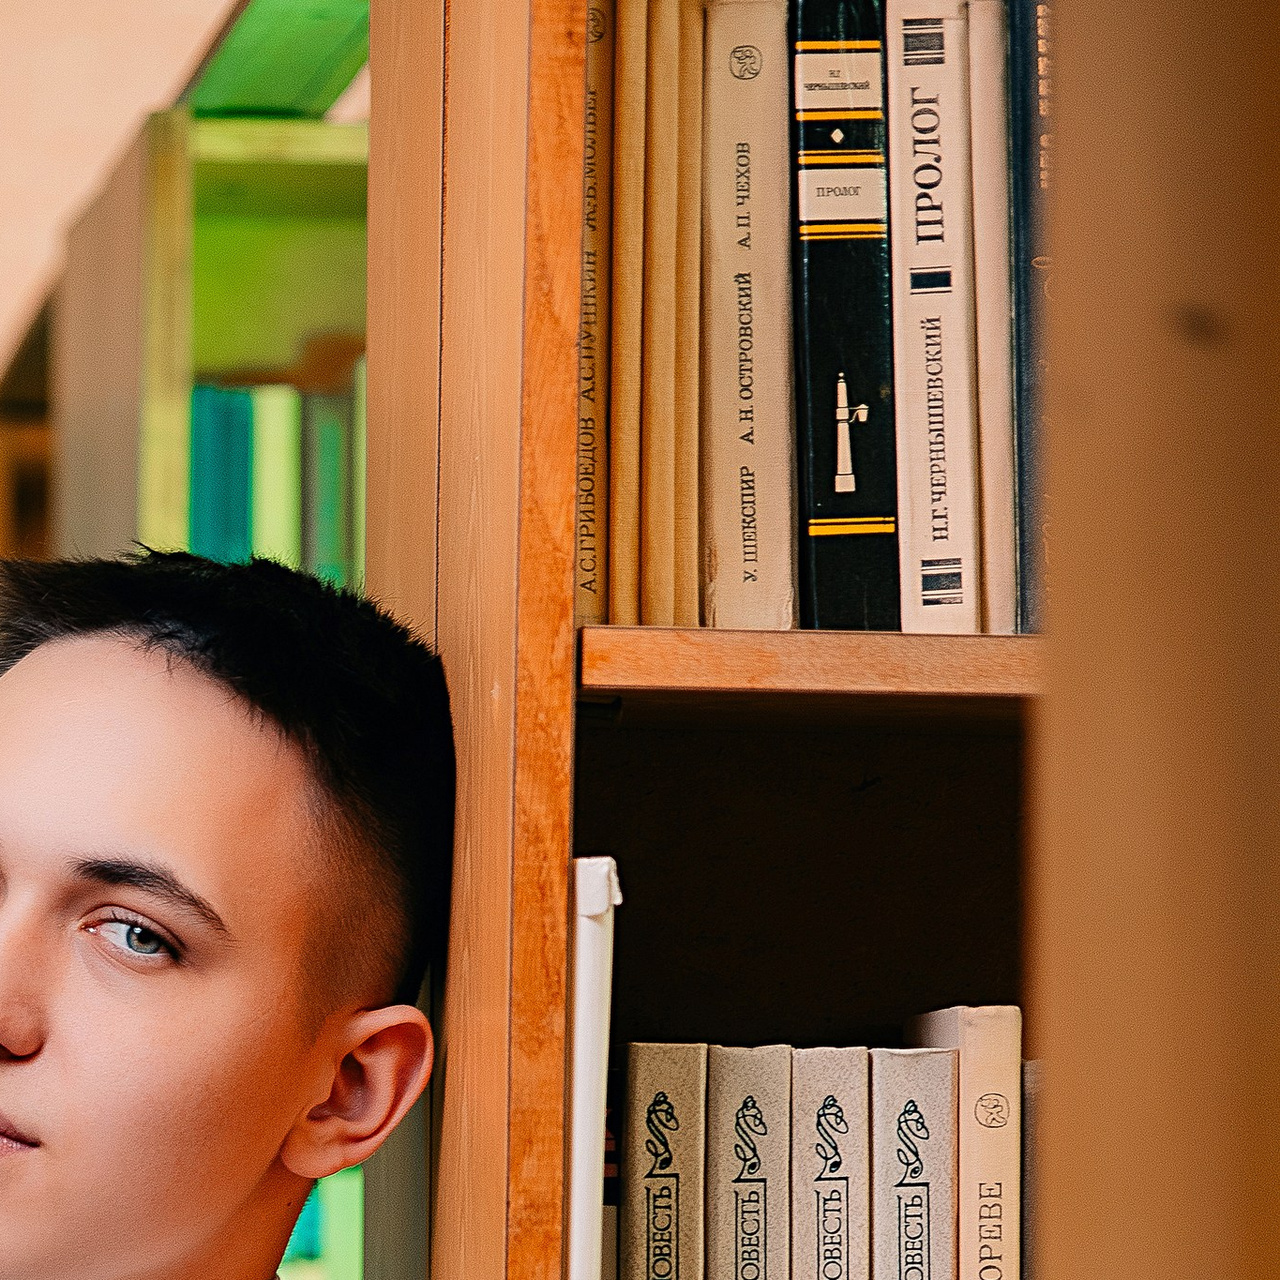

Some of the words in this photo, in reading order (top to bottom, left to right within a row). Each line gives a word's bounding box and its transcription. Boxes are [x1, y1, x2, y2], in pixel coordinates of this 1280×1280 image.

[735, 142, 751, 206] ЧЕХОВ
[816, 186, 861, 197] ПРОЛОГ
[911, 86, 945, 245] ПРОЛОГ
[733, 272, 754, 400] ОСТРОВСКИЙ
[740, 466, 757, 563] ШЕКСПИР
